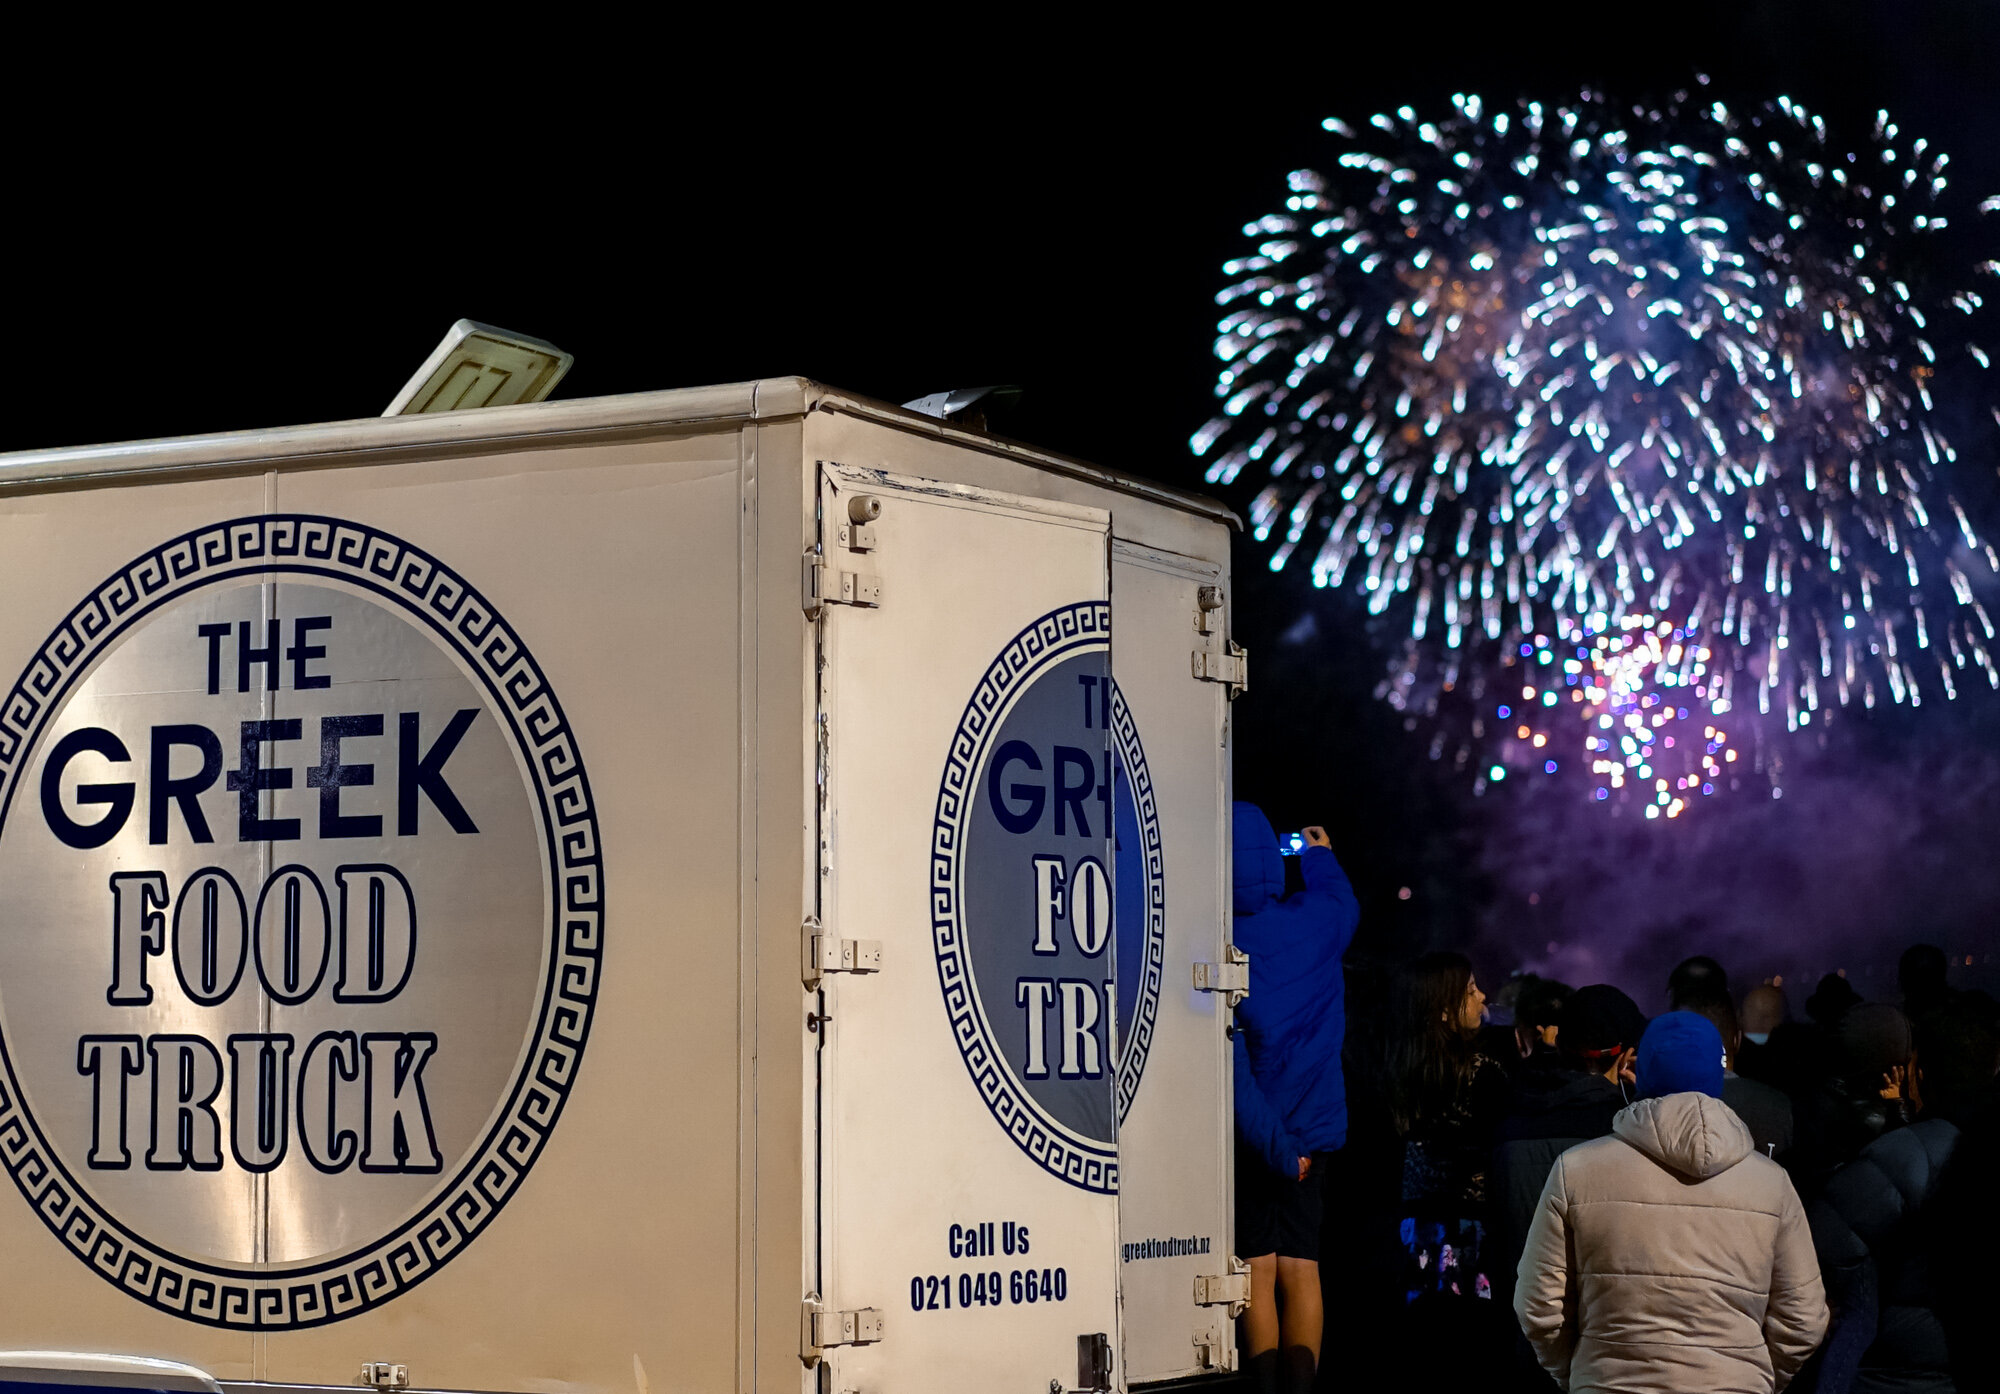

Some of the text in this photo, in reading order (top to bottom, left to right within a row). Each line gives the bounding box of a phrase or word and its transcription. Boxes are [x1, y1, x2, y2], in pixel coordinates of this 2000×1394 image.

[198, 616, 332, 695] THE
[40, 707, 481, 849] GREEK
[107, 864, 417, 1007] FOOD
[76, 1031, 443, 1174] TRUCK
[911, 1267, 1067, 1311] 021 049 6640
[949, 1221, 1029, 1258] Call Us
